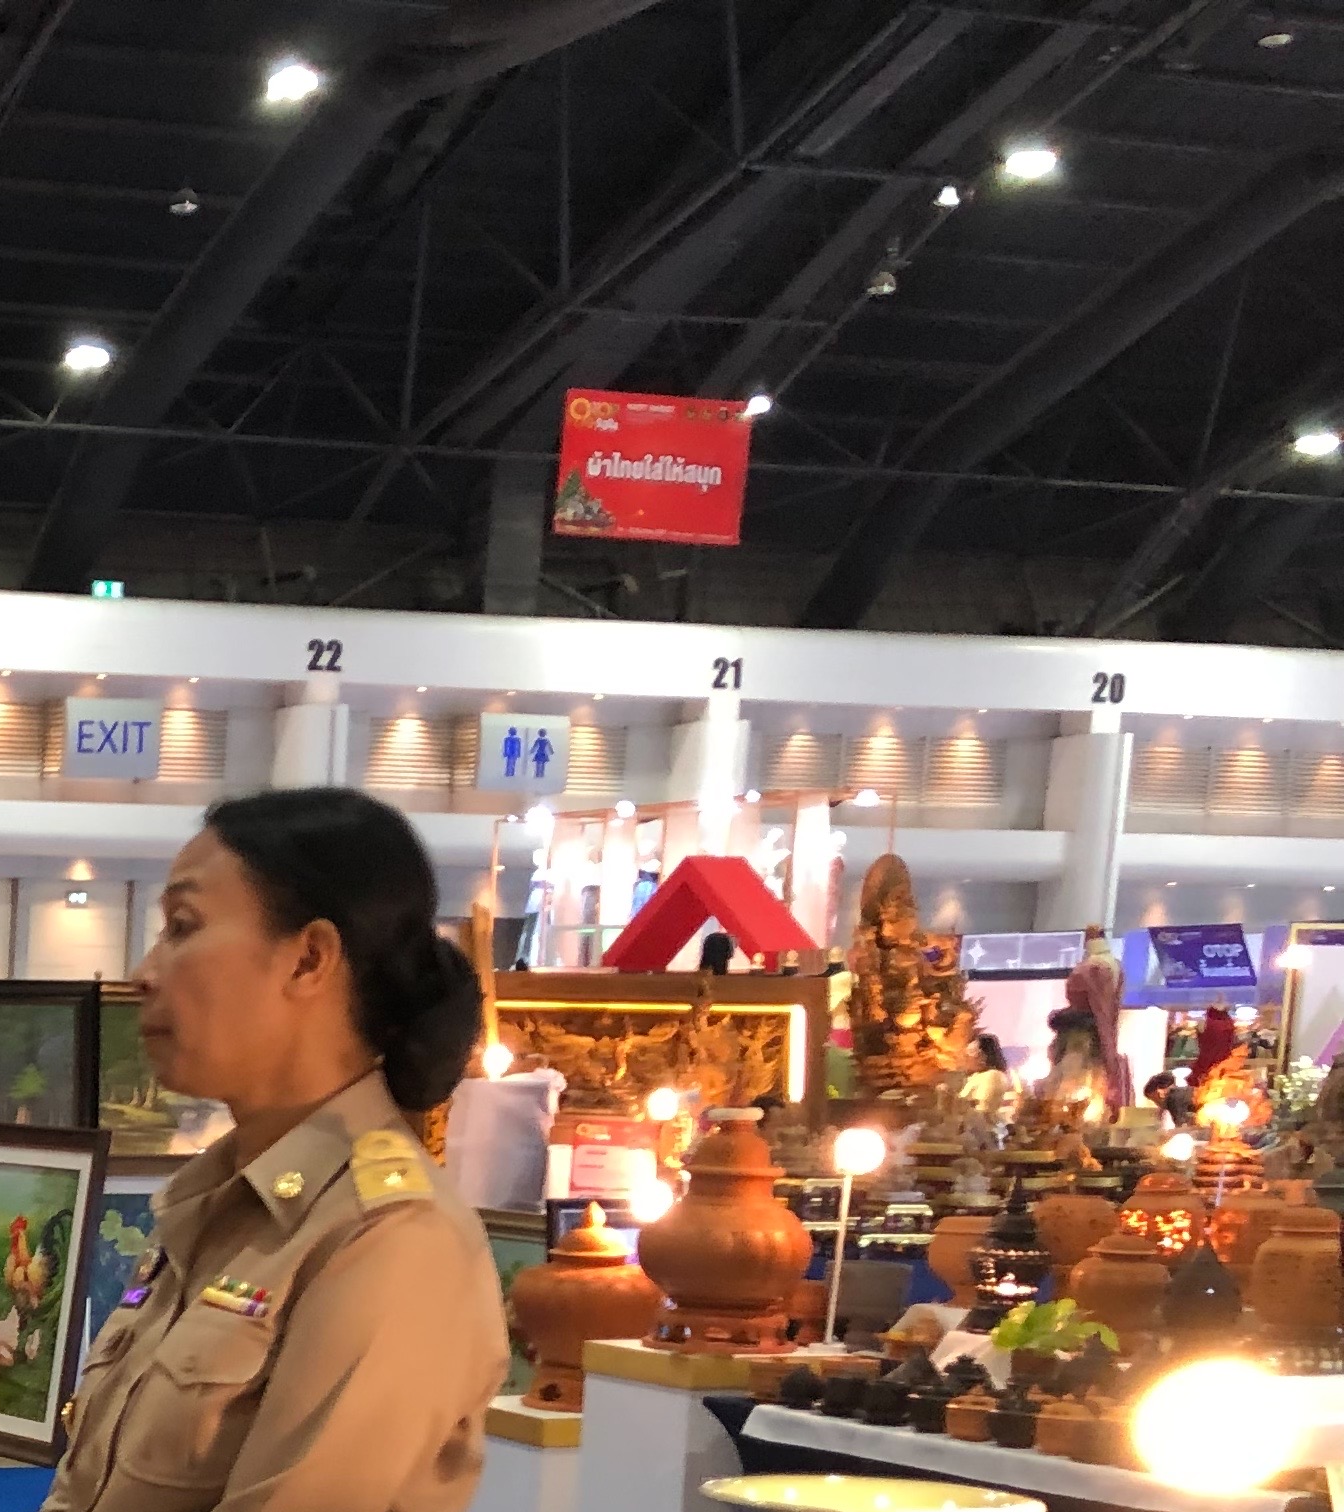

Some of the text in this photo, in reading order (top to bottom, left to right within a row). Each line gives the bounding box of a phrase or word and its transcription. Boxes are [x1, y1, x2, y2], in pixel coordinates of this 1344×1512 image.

[308, 639, 343, 673] 22
[712, 658, 743, 690] 21
[1092, 673, 1126, 704] 20
[76, 720, 152, 755] EXIT
